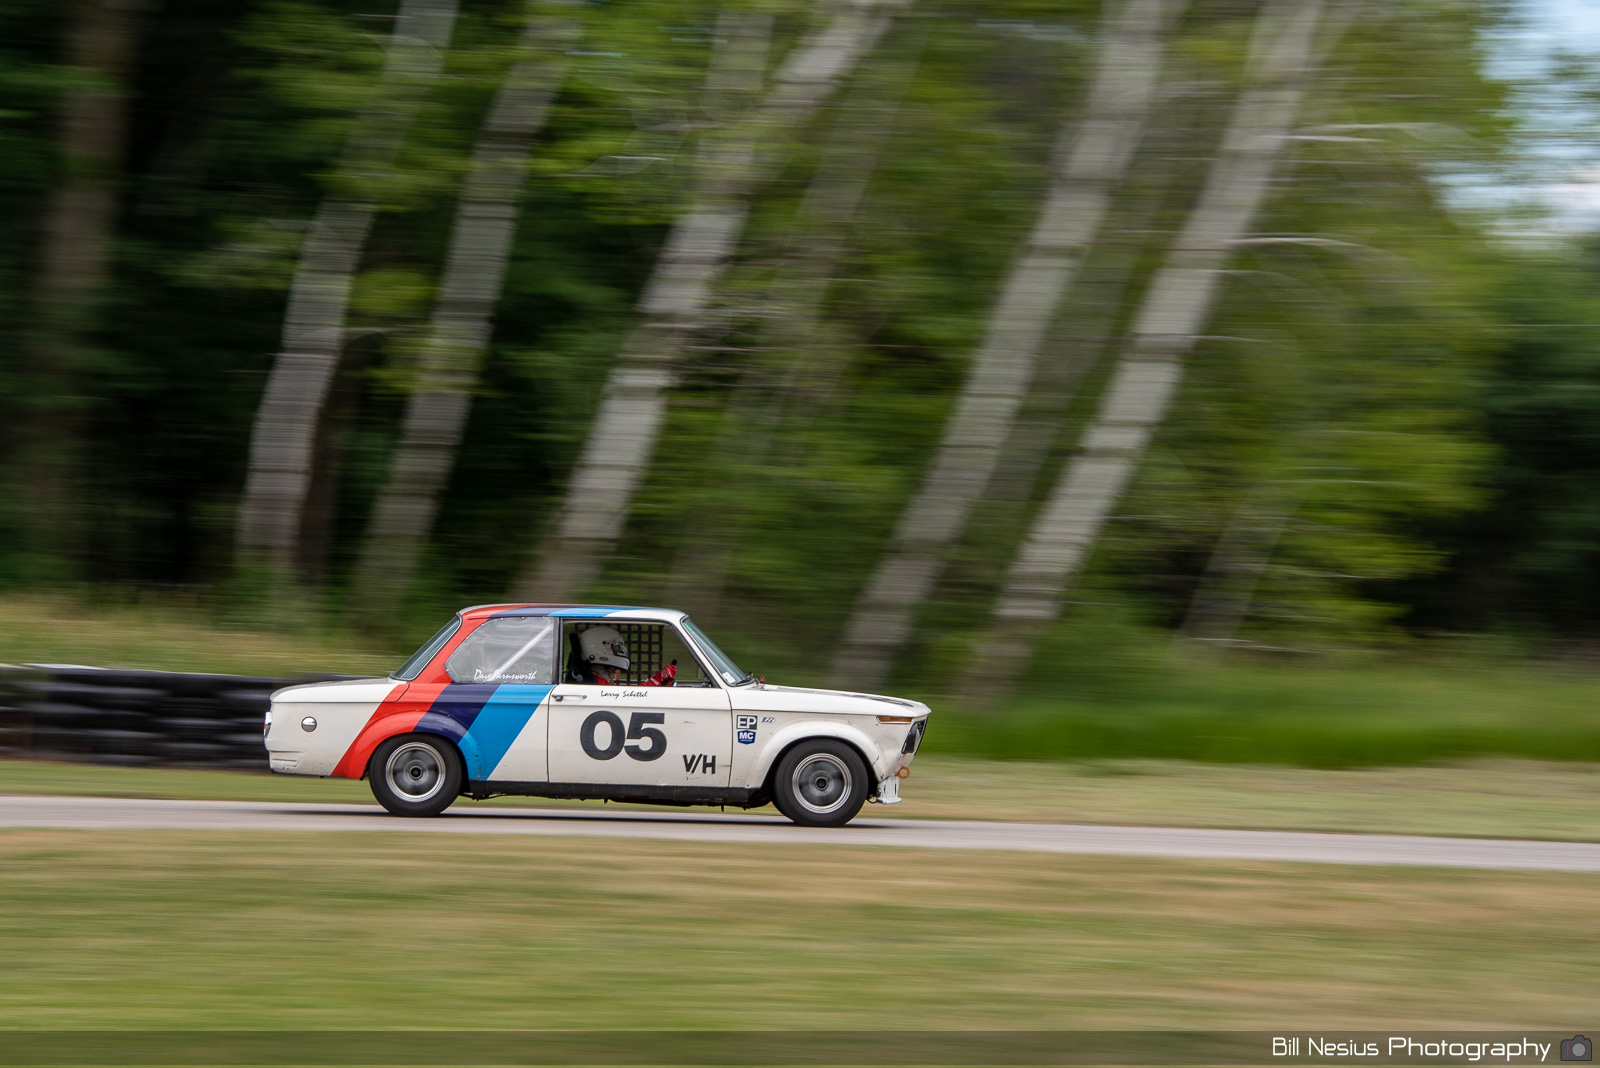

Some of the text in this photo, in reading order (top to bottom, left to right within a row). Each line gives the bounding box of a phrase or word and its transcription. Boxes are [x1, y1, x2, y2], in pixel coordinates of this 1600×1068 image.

[473, 669, 538, 681] Dave arnsworth
[600, 690, 620, 699] Larry
[737, 715, 757, 729] EP
[580, 710, 667, 762] 05
[739, 732, 754, 740] MC
[682, 753, 717, 775] V/H
